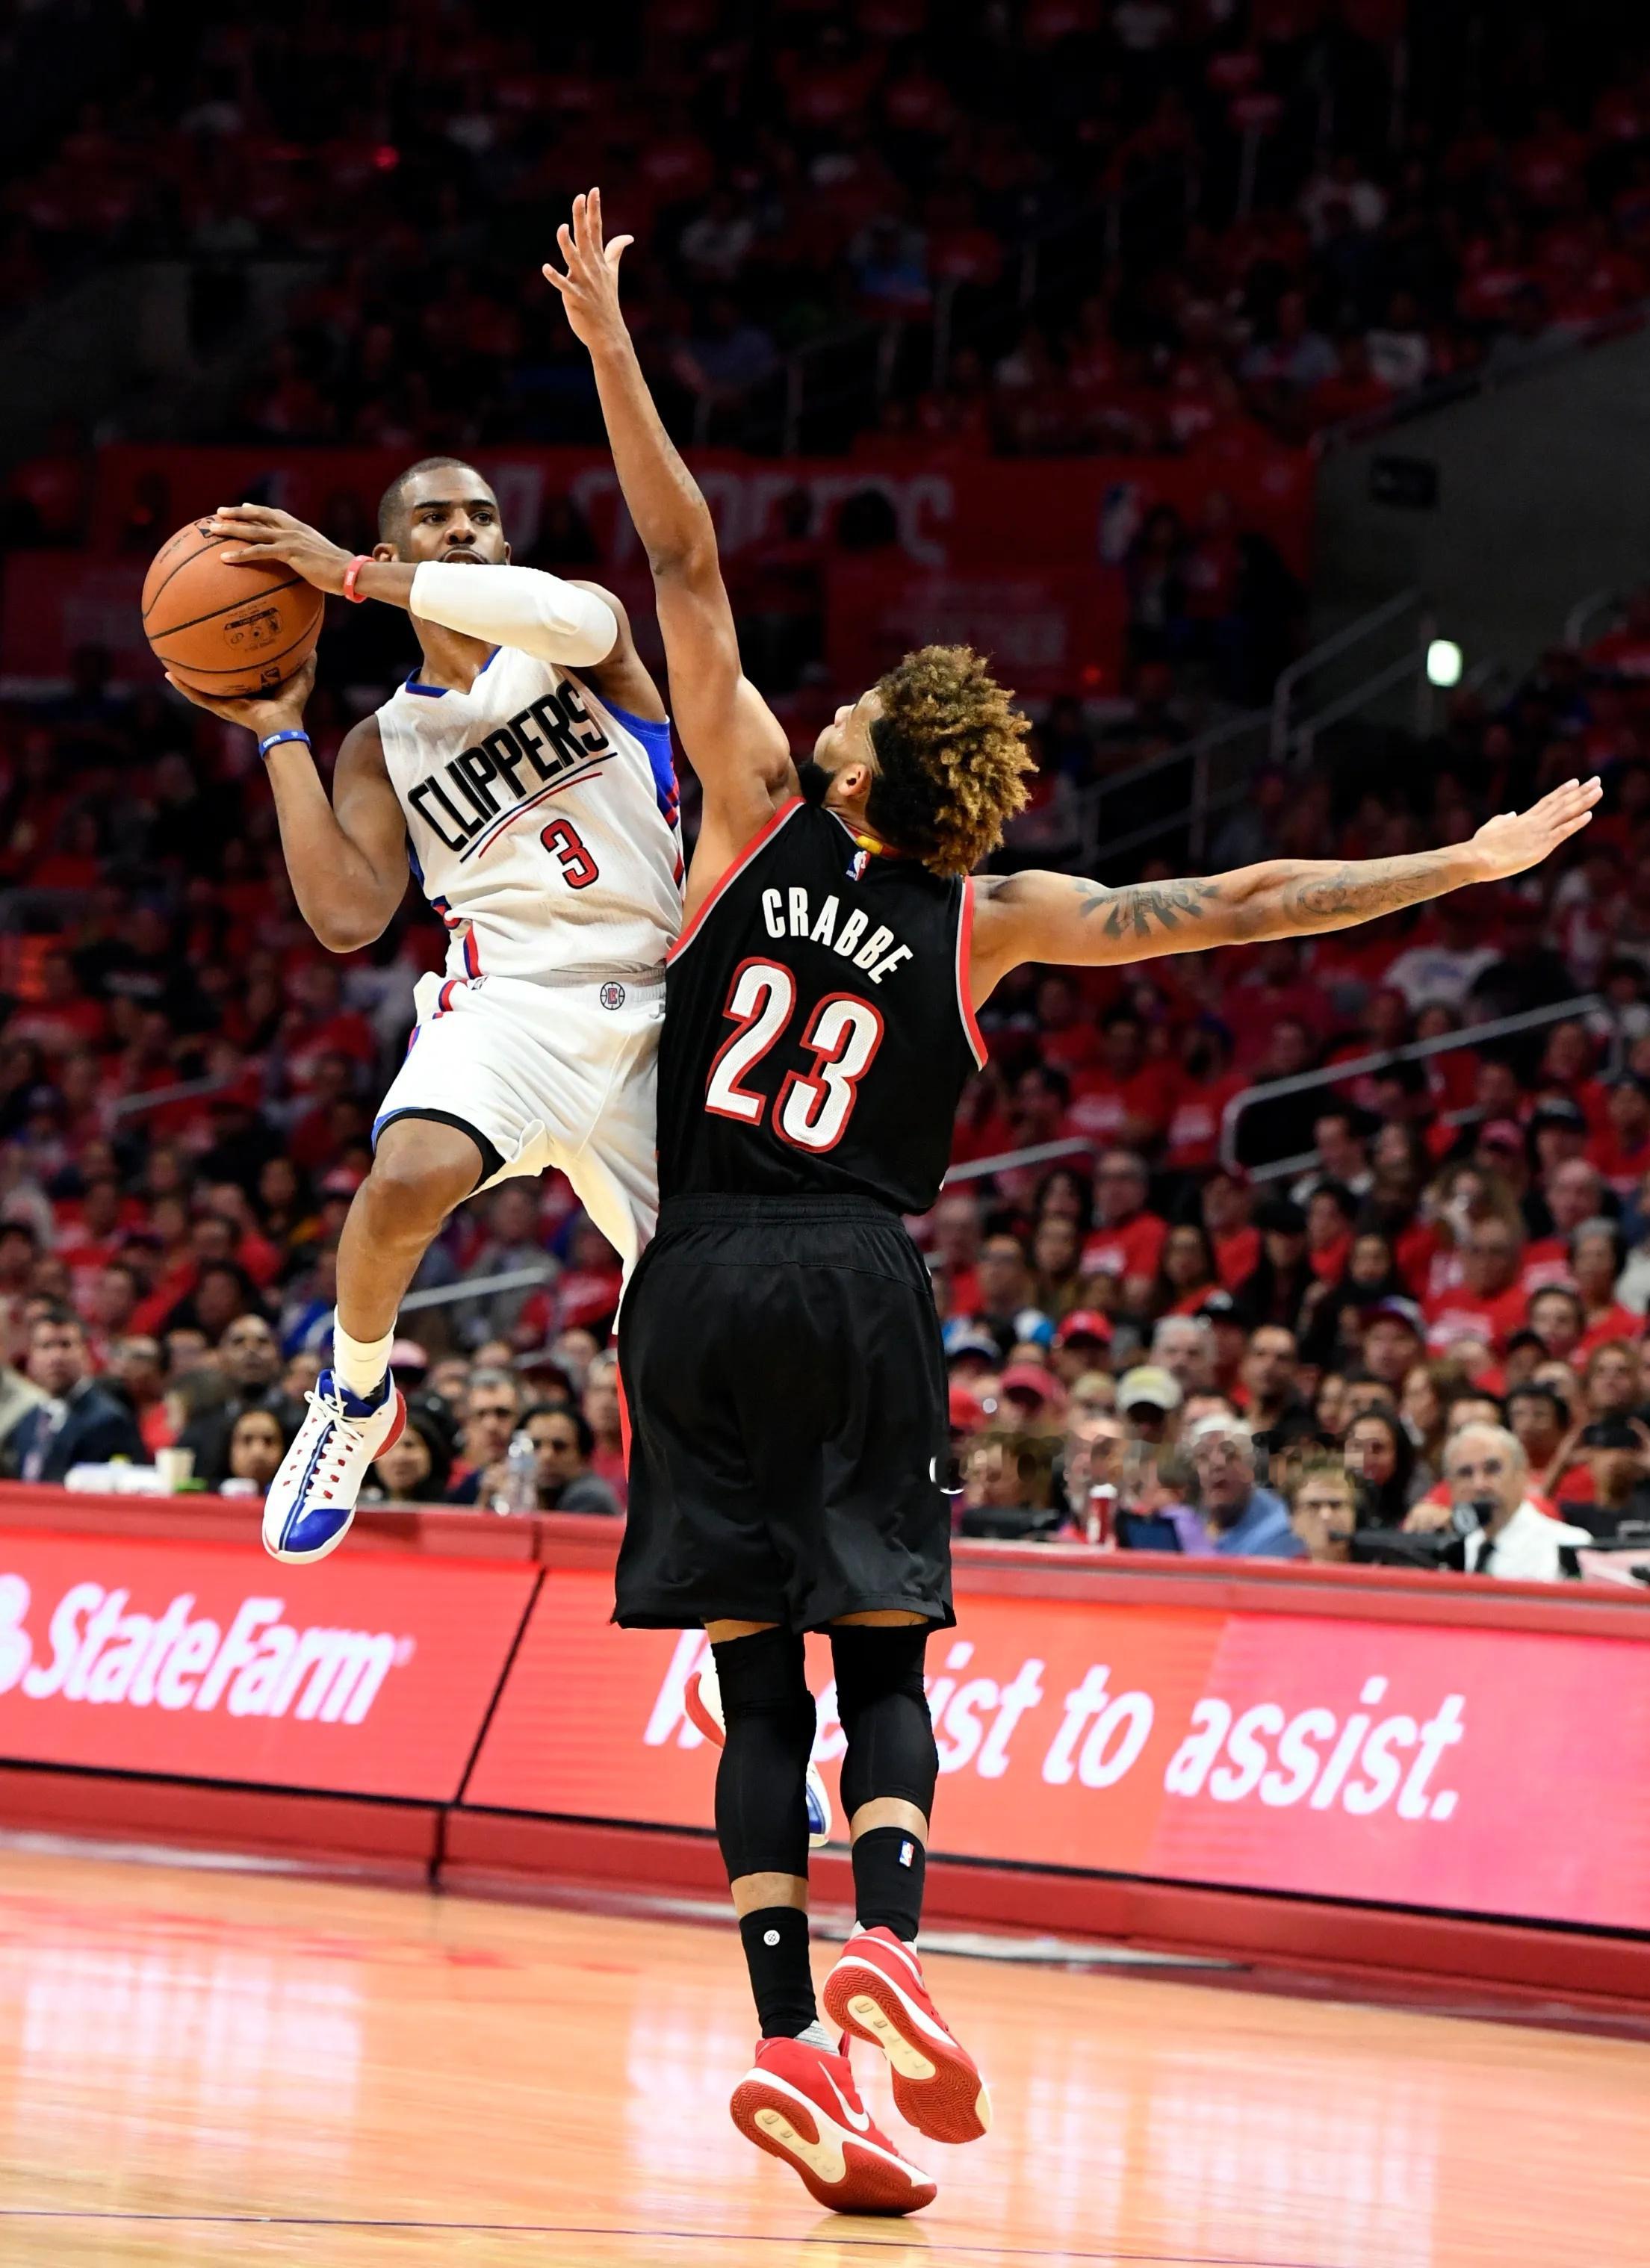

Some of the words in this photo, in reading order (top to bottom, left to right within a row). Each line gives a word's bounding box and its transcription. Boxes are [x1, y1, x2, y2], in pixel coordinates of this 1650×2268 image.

[408, 680, 610, 852] CLIPPERS
[540, 818, 599, 889] 3
[762, 887, 914, 984] CRABBE
[705, 957, 884, 1153] 23
[1041, 1664, 1154, 1789] to
[1164, 1675, 1466, 1821] assist.
